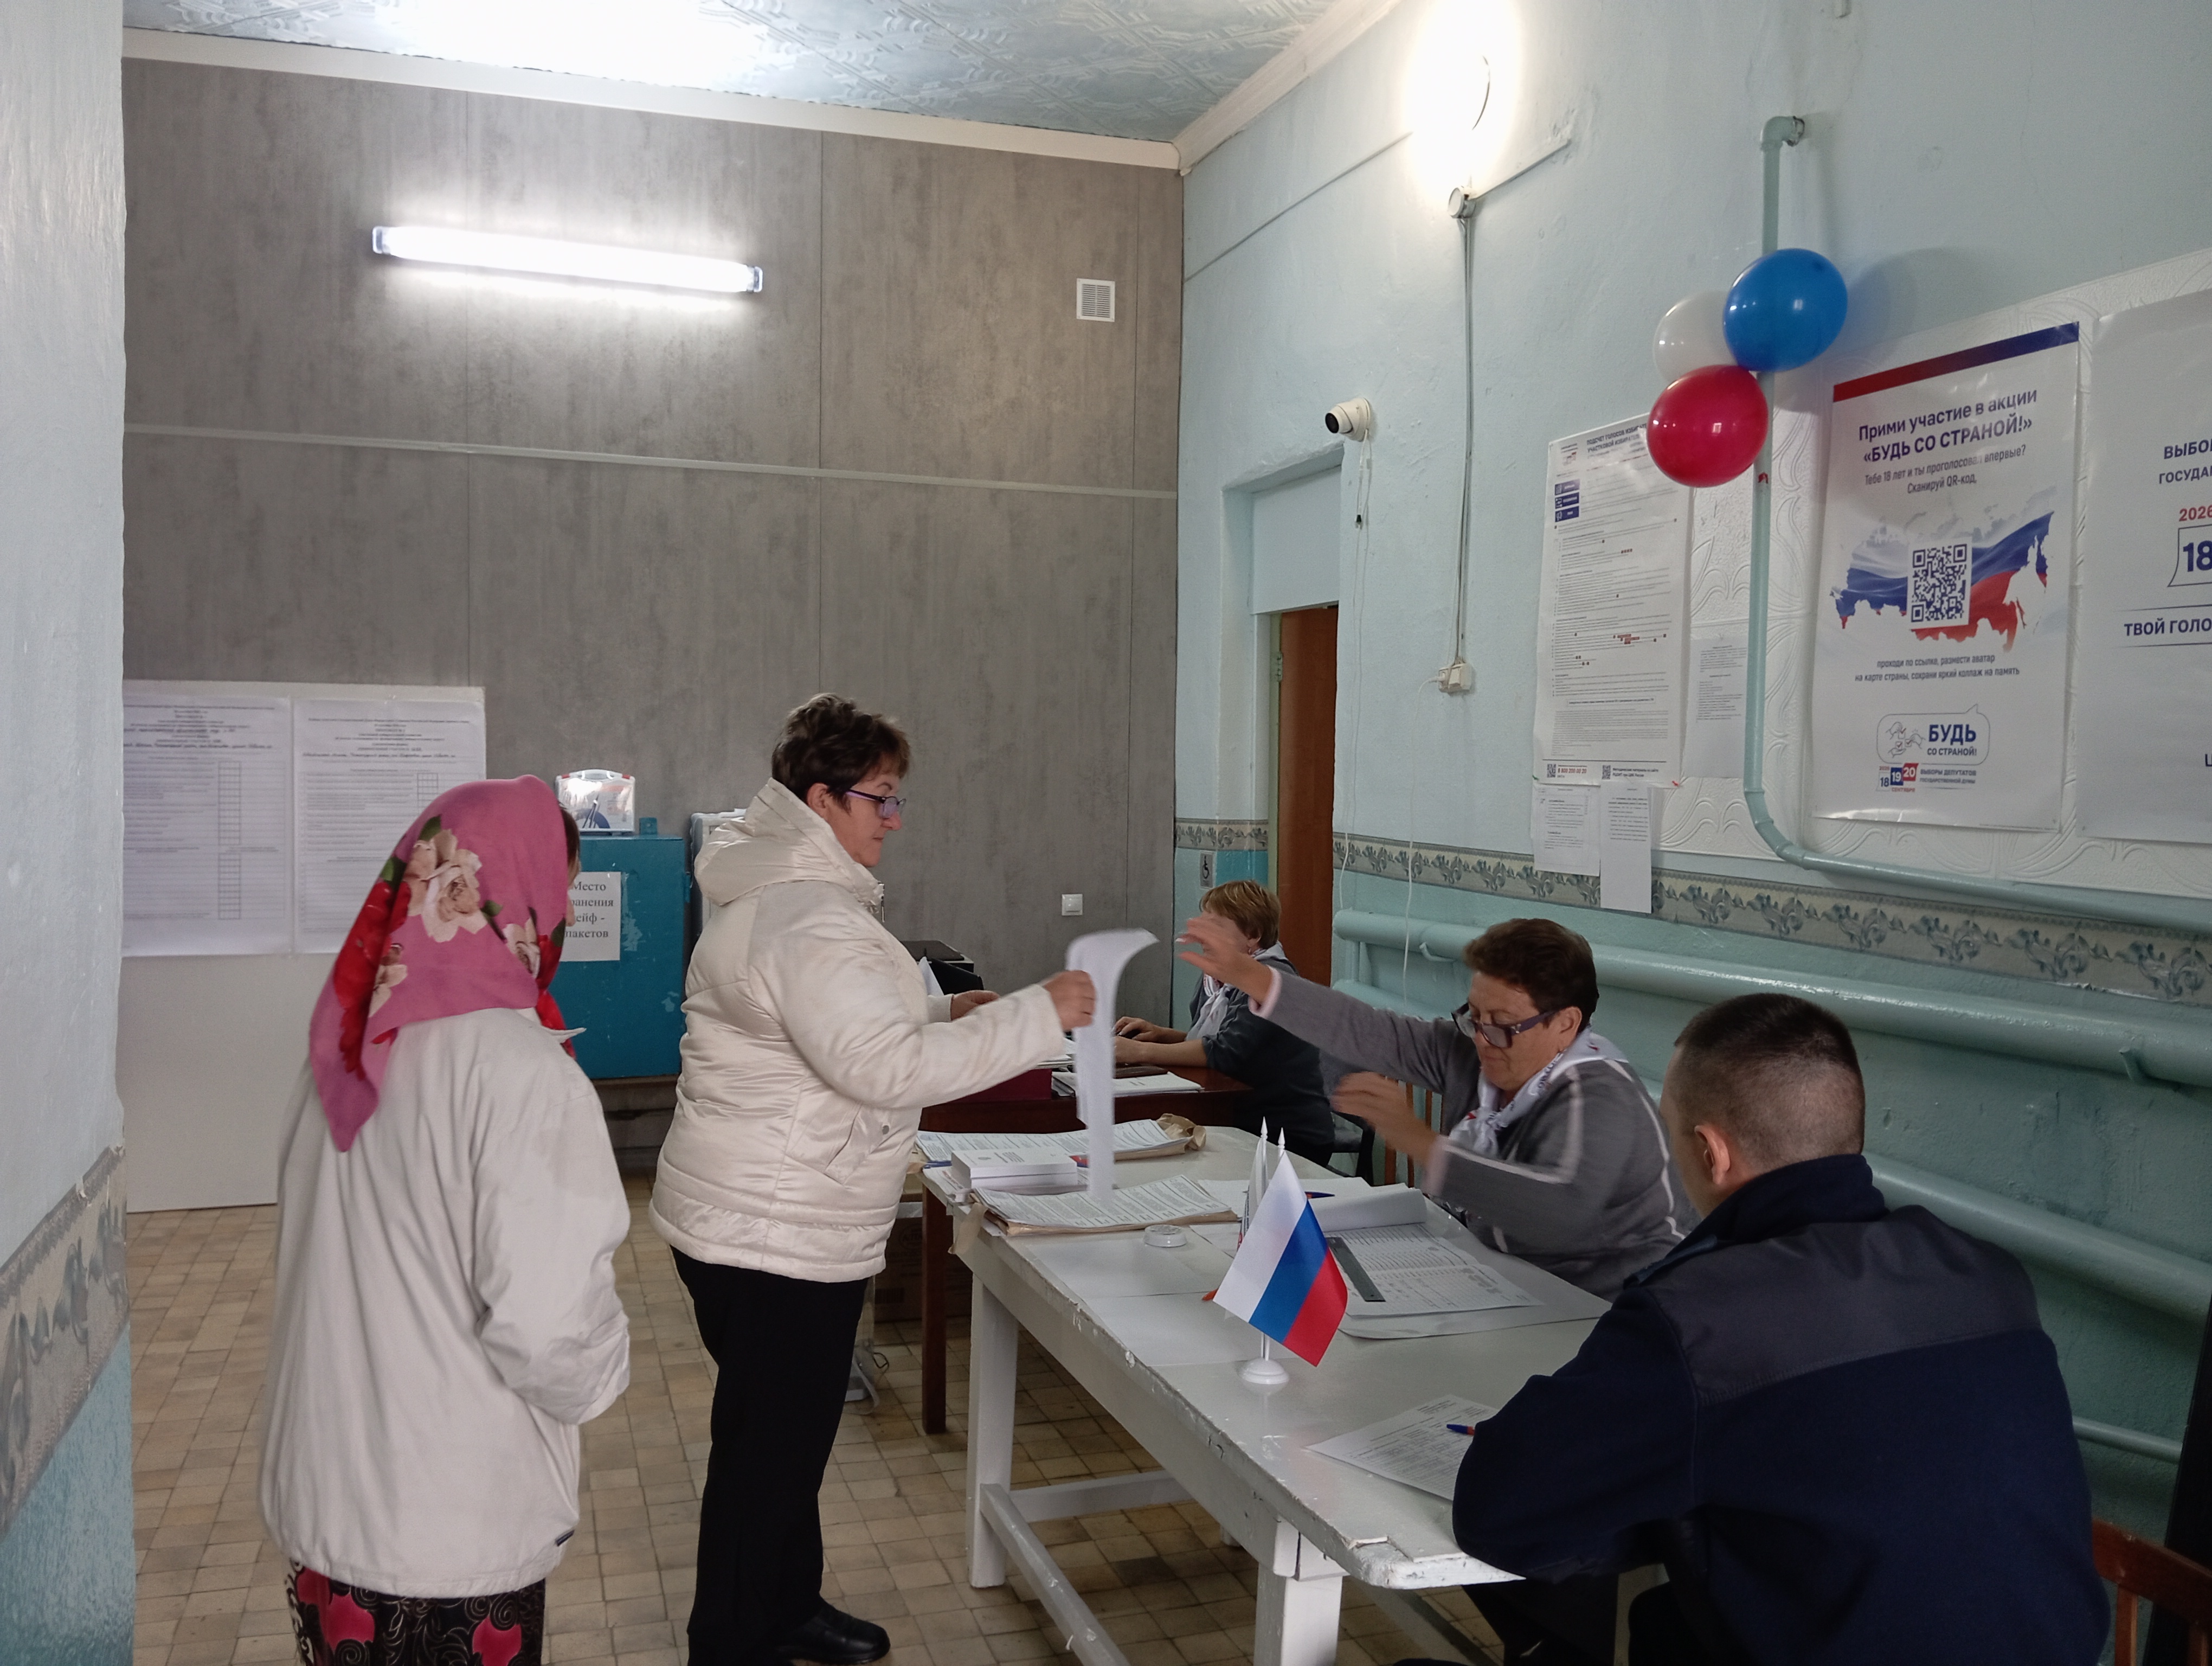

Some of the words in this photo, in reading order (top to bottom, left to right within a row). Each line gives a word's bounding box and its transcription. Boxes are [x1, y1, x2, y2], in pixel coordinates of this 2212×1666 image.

[1859, 420, 1906, 443] Прими
[1909, 406, 1971, 433] участие
[1975, 402, 1984, 415] в
[1988, 390, 2037, 412] акции
[1864, 441, 1911, 462] «БУДЬ
[1914, 435, 1935, 453] СО
[1940, 412, 2032, 448] СТРАНОЙ!»
[2163, 438, 2212, 459] ВЫБО
[1865, 473, 1882, 485] Тебе
[1883, 471, 1891, 482] 18
[1892, 469, 1906, 480] лет
[1907, 467, 1913, 477] и
[1914, 465, 1925, 476] ты
[1984, 444, 2026, 463] впервые?
[2159, 465, 2212, 484] ГОСУДА
[1907, 477, 1945, 494] Сканируй
[2178, 504, 2212, 522] 2026
[2183, 540, 2212, 573] 18
[2124, 617, 2165, 637] ТВОЙ
[2169, 618, 2212, 635] ГОЛО
[1877, 659, 1904, 668] проходи
[1972, 655, 1995, 663] аватар
[1864, 673, 1883, 682] карте
[1995, 667, 2020, 676] память
[1928, 724, 1977, 746] БУДЬ
[1939, 746, 1977, 756] СТРАНОЙ!
[1880, 777, 1890, 787] 18
[1892, 772, 1901, 782] 19
[1903, 767, 1915, 778] 20
[574, 881, 606, 891] Место
[576, 913, 597, 925] ейф
